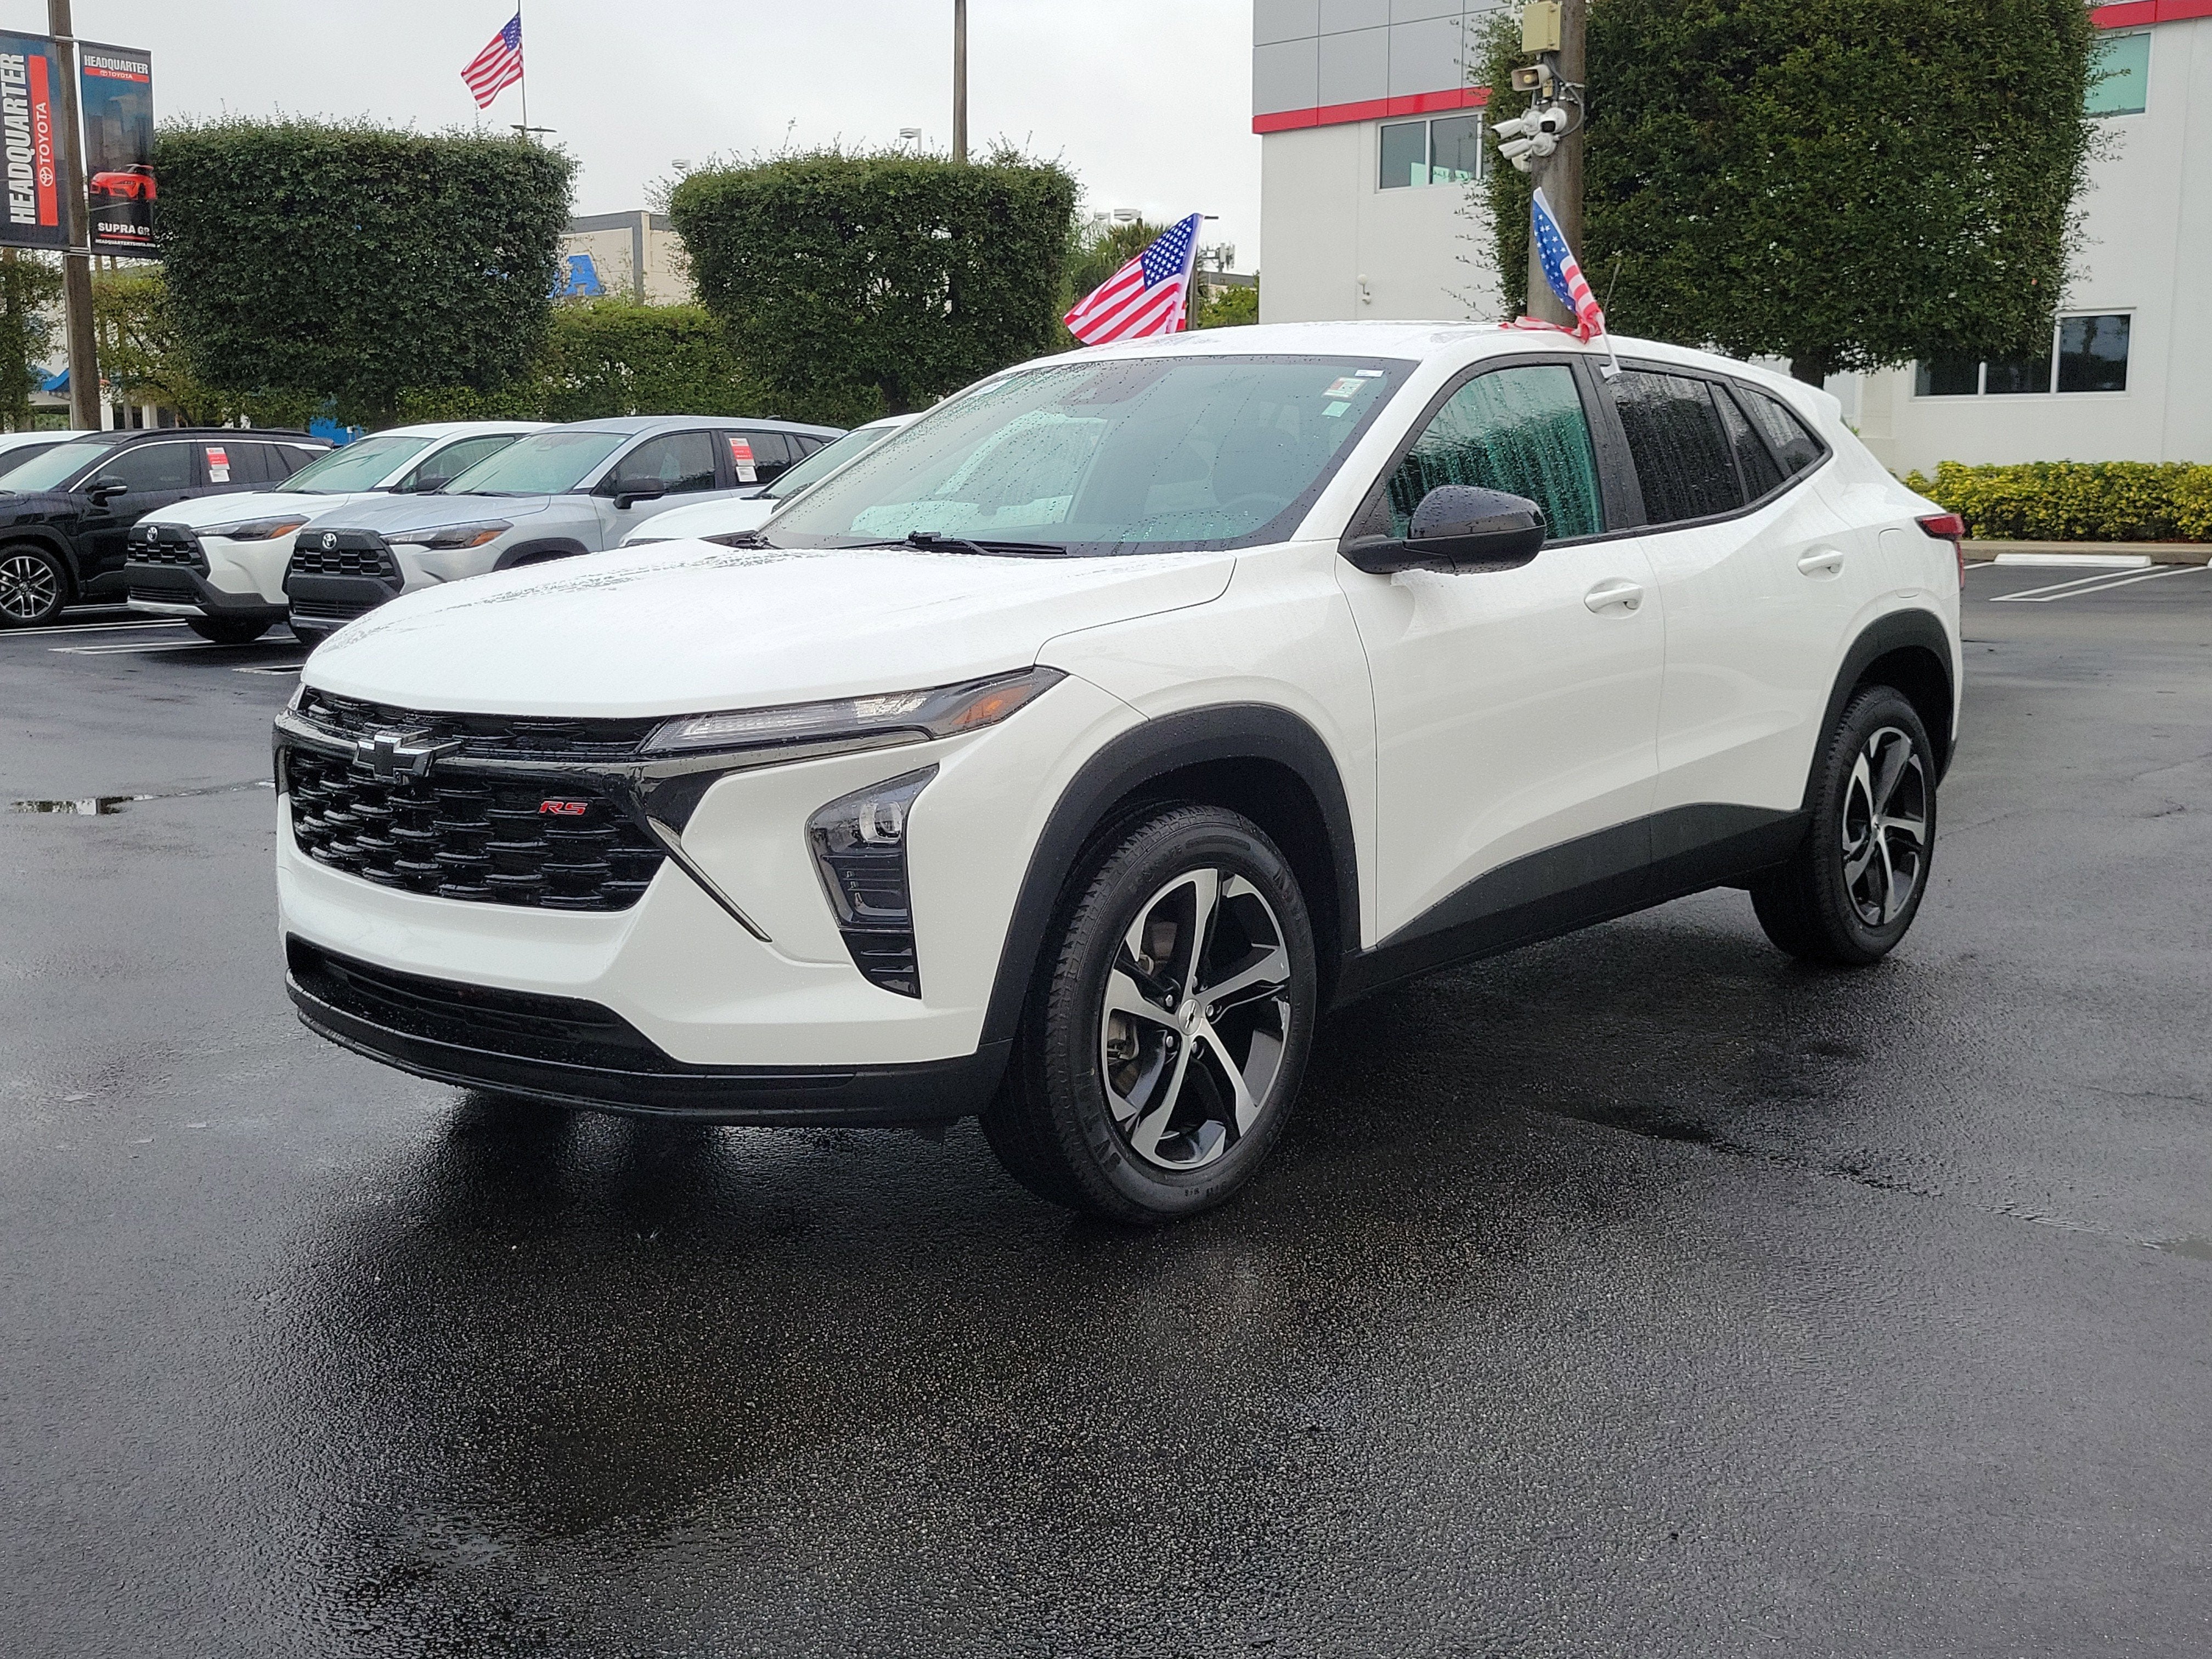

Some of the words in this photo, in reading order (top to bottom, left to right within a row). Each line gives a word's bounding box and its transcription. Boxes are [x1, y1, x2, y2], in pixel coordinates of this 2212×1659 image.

[84, 55, 148, 74] HEADQUARTER
[109, 71, 133, 79] TOYOTA
[0, 54, 36, 224] HEADQUARTER
[36, 102, 50, 165] TOYOTA
[98, 222, 136, 234] SUPRA
[137, 225, 150, 236] GR
[539, 800, 588, 815] RS
